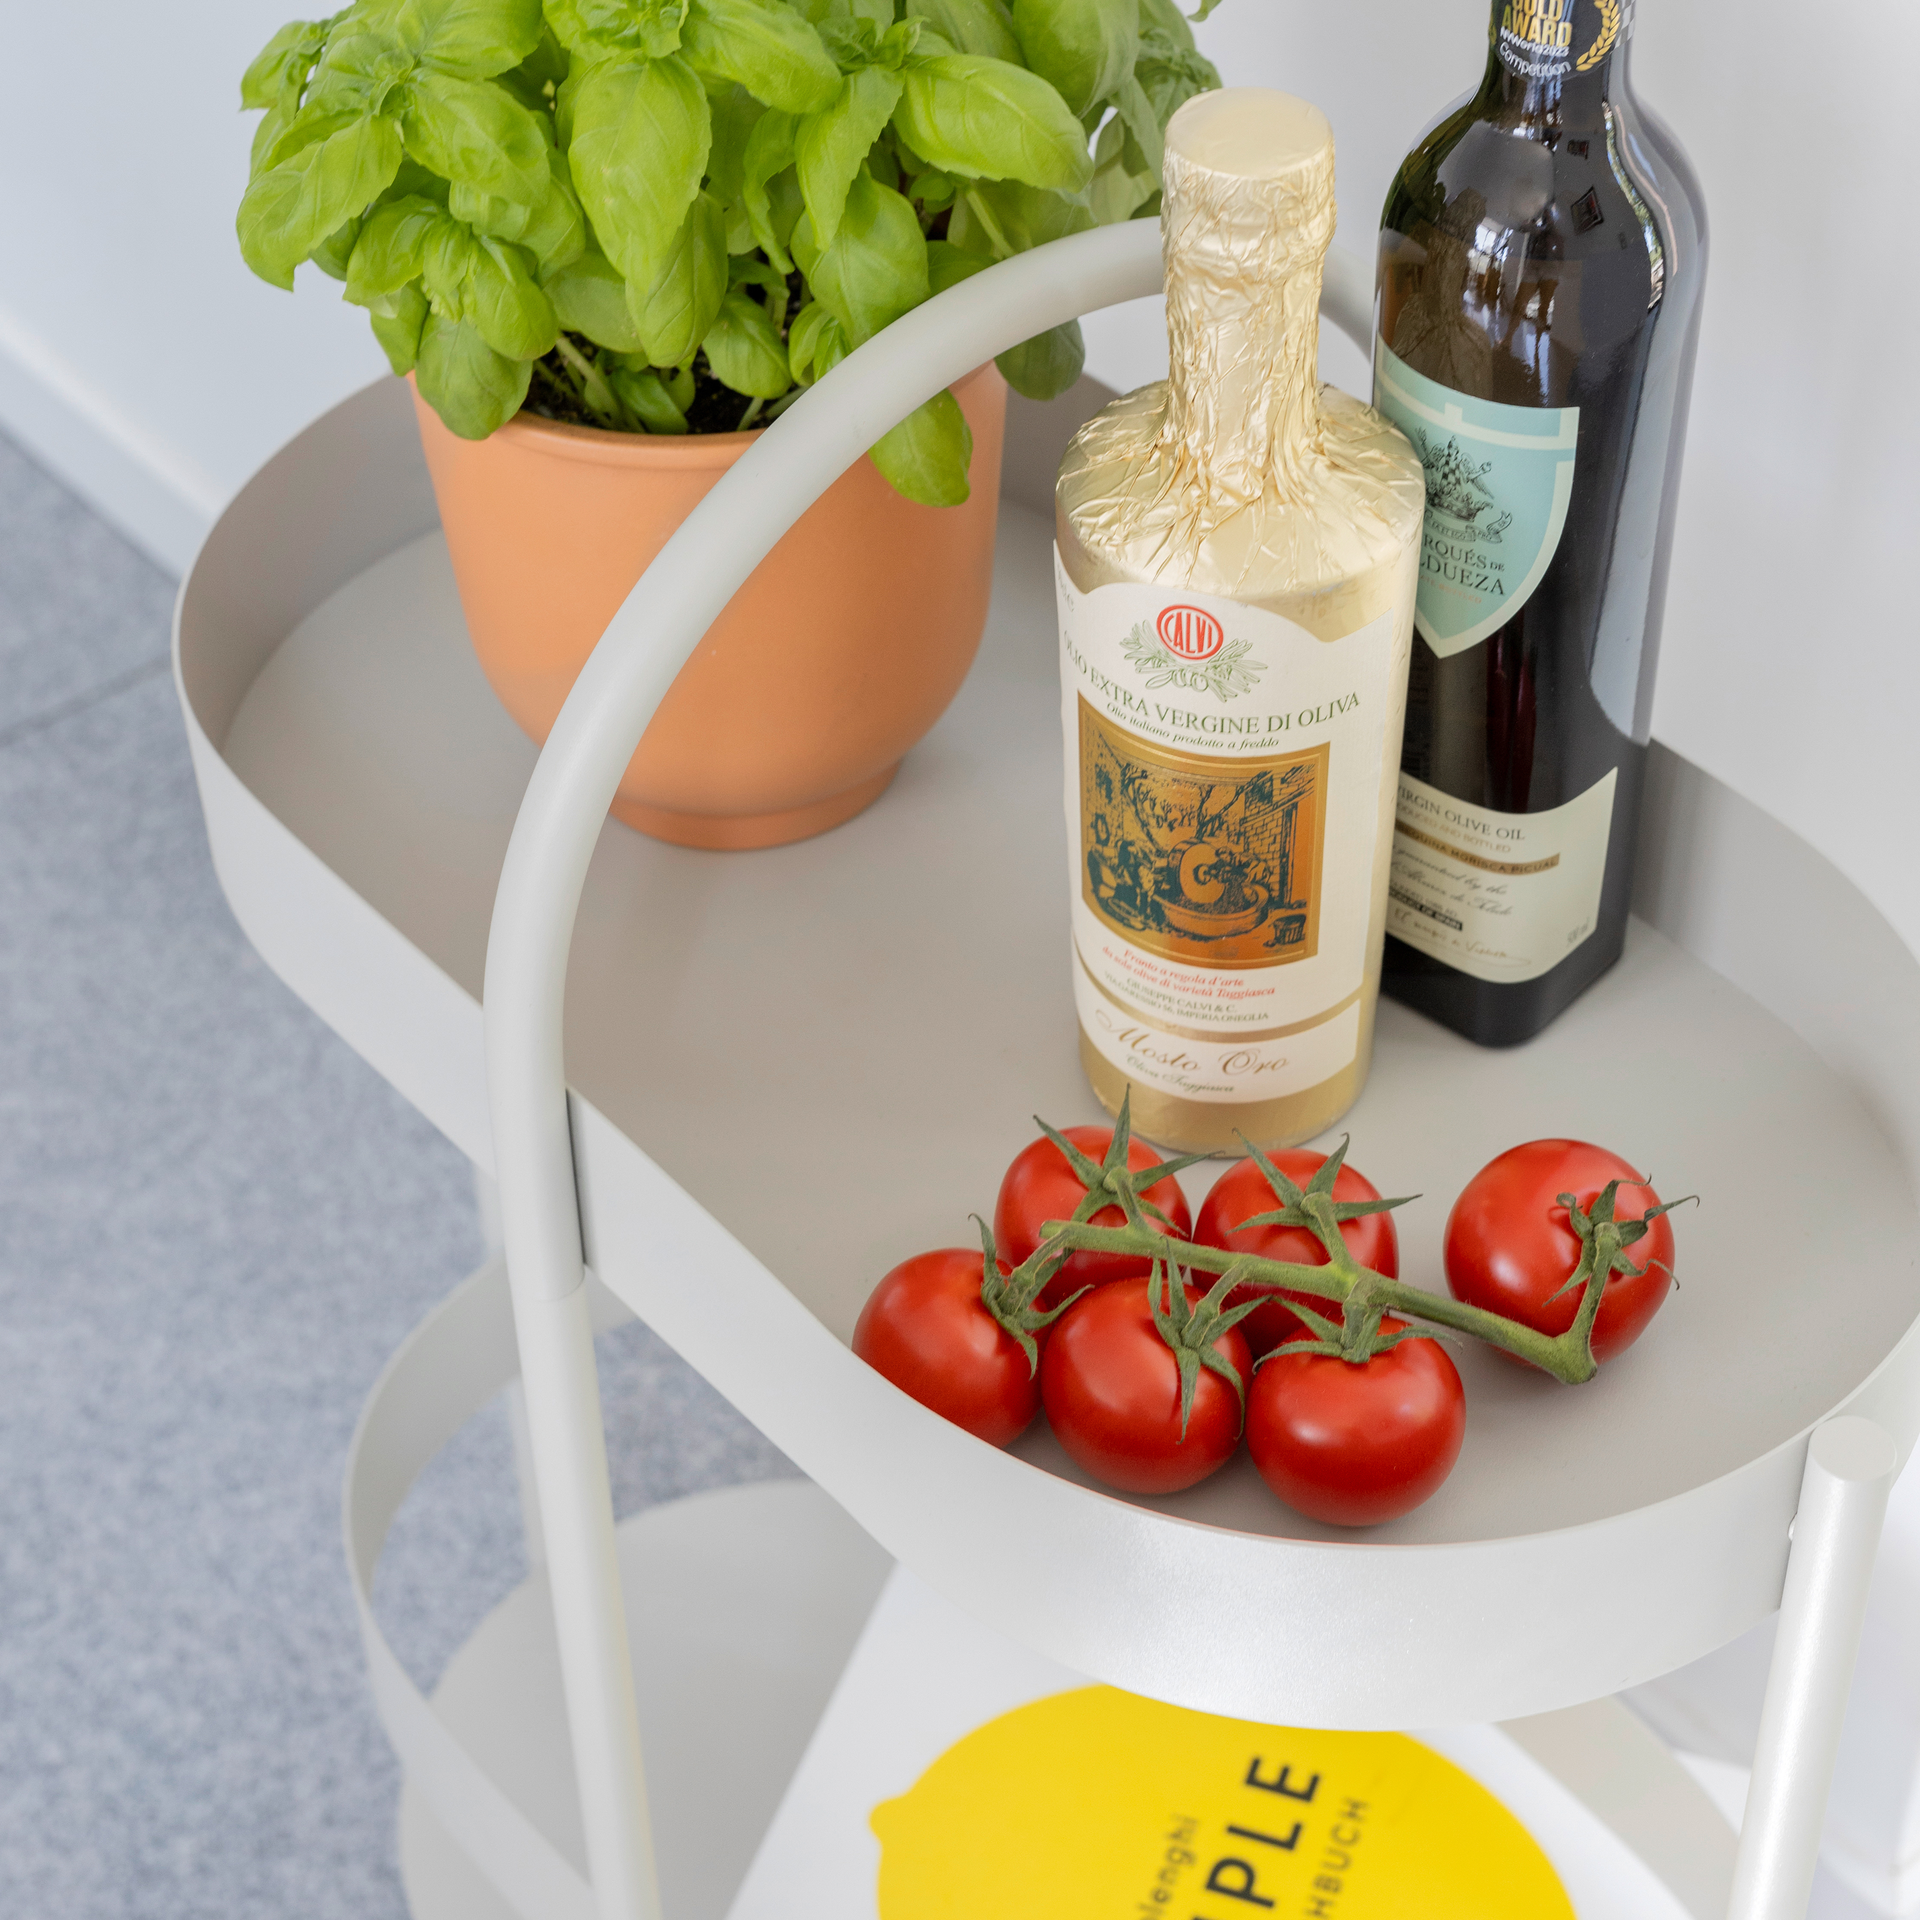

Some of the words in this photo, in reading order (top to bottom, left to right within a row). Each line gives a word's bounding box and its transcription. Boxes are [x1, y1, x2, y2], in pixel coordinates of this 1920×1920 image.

[1502, 4, 1573, 47] AWARD
[1500, 41, 1572, 77] Competition
[1490, 561, 1506, 572] DE
[1163, 610, 1213, 654] CALVI
[1064, 630, 1087, 675] OLIO
[1090, 665, 1149, 716] EXTRA
[1154, 703, 1260, 735] VERGINE
[1267, 712, 1292, 733] DI
[1298, 691, 1361, 727] OLIVA
[1106, 702, 1127, 722] Olio
[1130, 713, 1171, 739] italiano
[1171, 730, 1225, 750] prodotto
[1227, 740, 1237, 749] a
[1238, 736, 1280, 752] freddo
[1444, 809, 1492, 836] OLIVE
[1496, 828, 1526, 841] OIL
[1463, 834, 1512, 853] BOTTLED
[1450, 849, 1507, 873] MORISCA
[1133, 967, 1158, 983] olive
[1159, 976, 1171, 988] di
[1169, 972, 1207, 986] regola
[1177, 997, 1213, 1011] CALVI
[1213, 1004, 1224, 1012] &
[1095, 1009, 1202, 1071] Mosto
[1218, 1047, 1290, 1076] Oro
[1191, 1756, 1321, 1920] PLE
